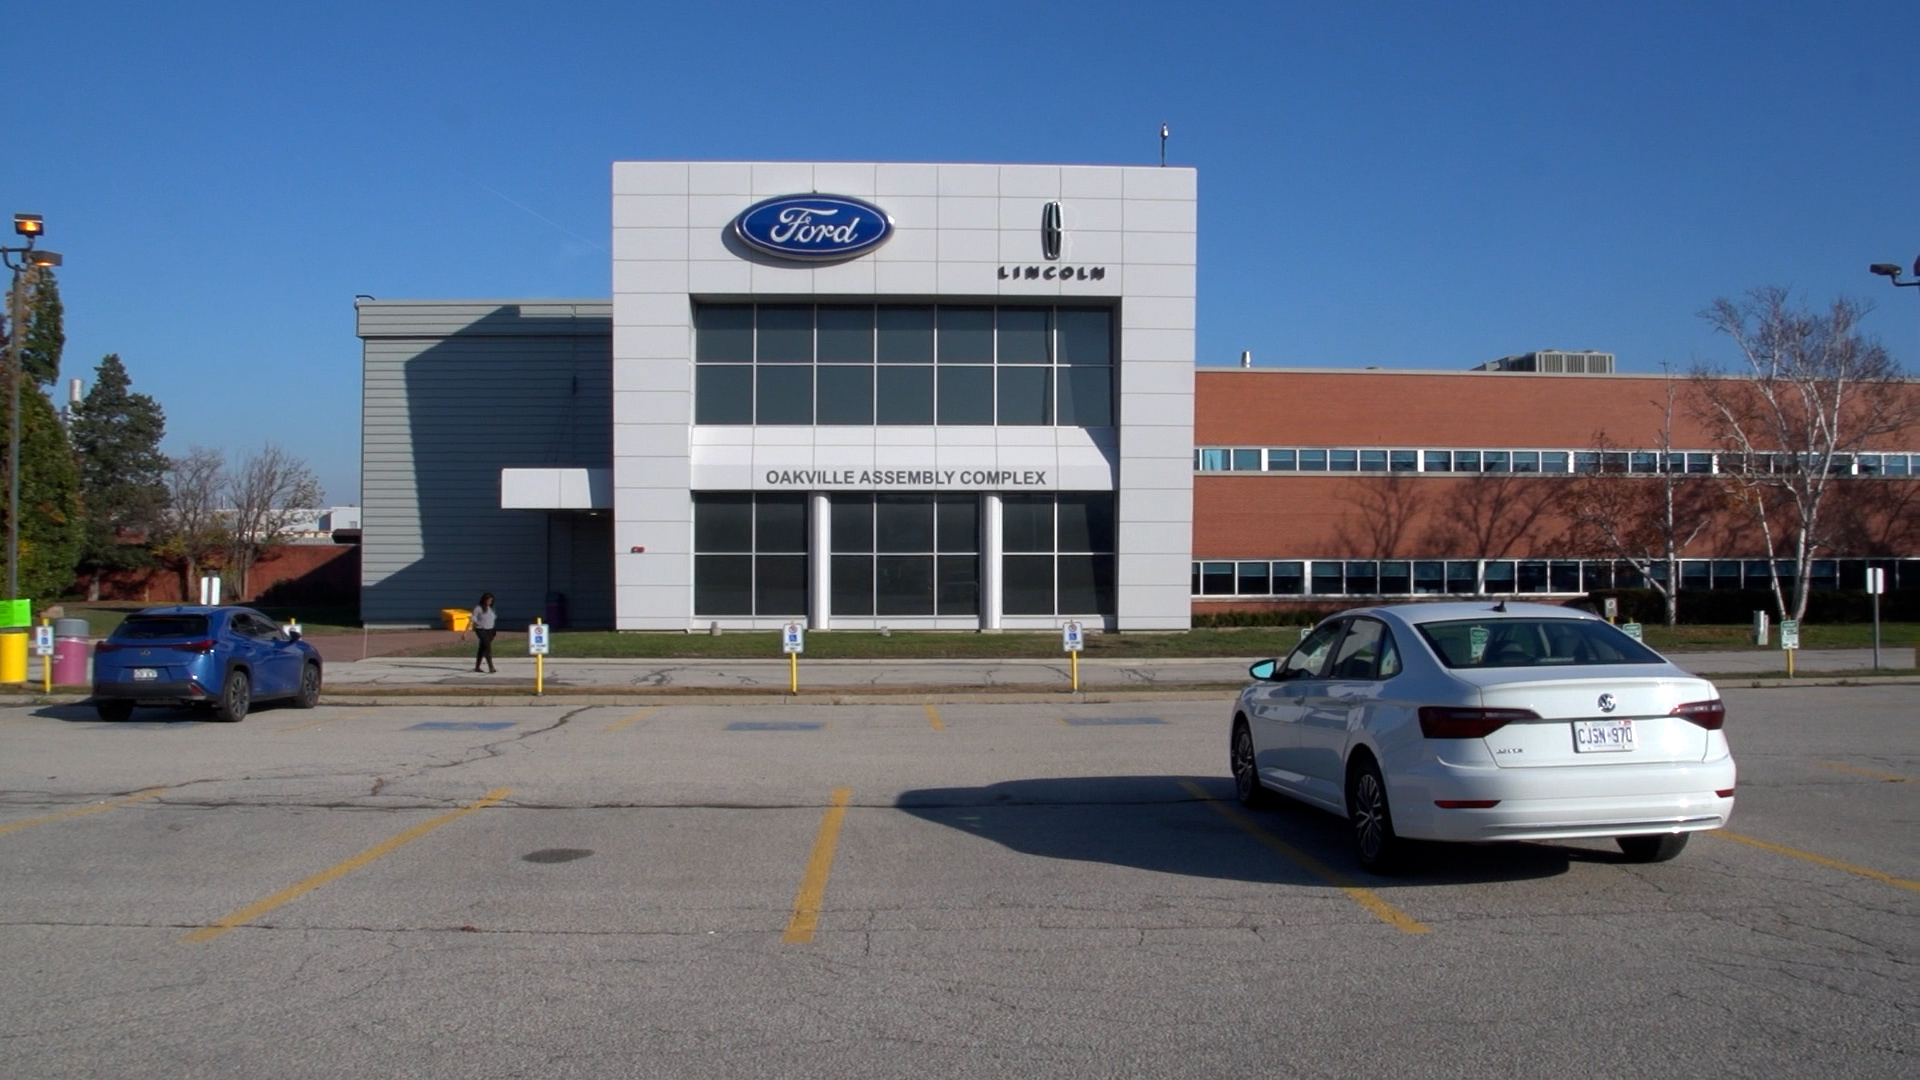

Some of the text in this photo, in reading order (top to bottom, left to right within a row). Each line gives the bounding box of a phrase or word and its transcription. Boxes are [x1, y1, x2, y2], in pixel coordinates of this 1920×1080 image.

[770, 207, 860, 243] Ford
[997, 266, 1105, 281] LINCOLN
[766, 470, 1047, 485] OAKVILLE ASSEMBLY COMPLEX
